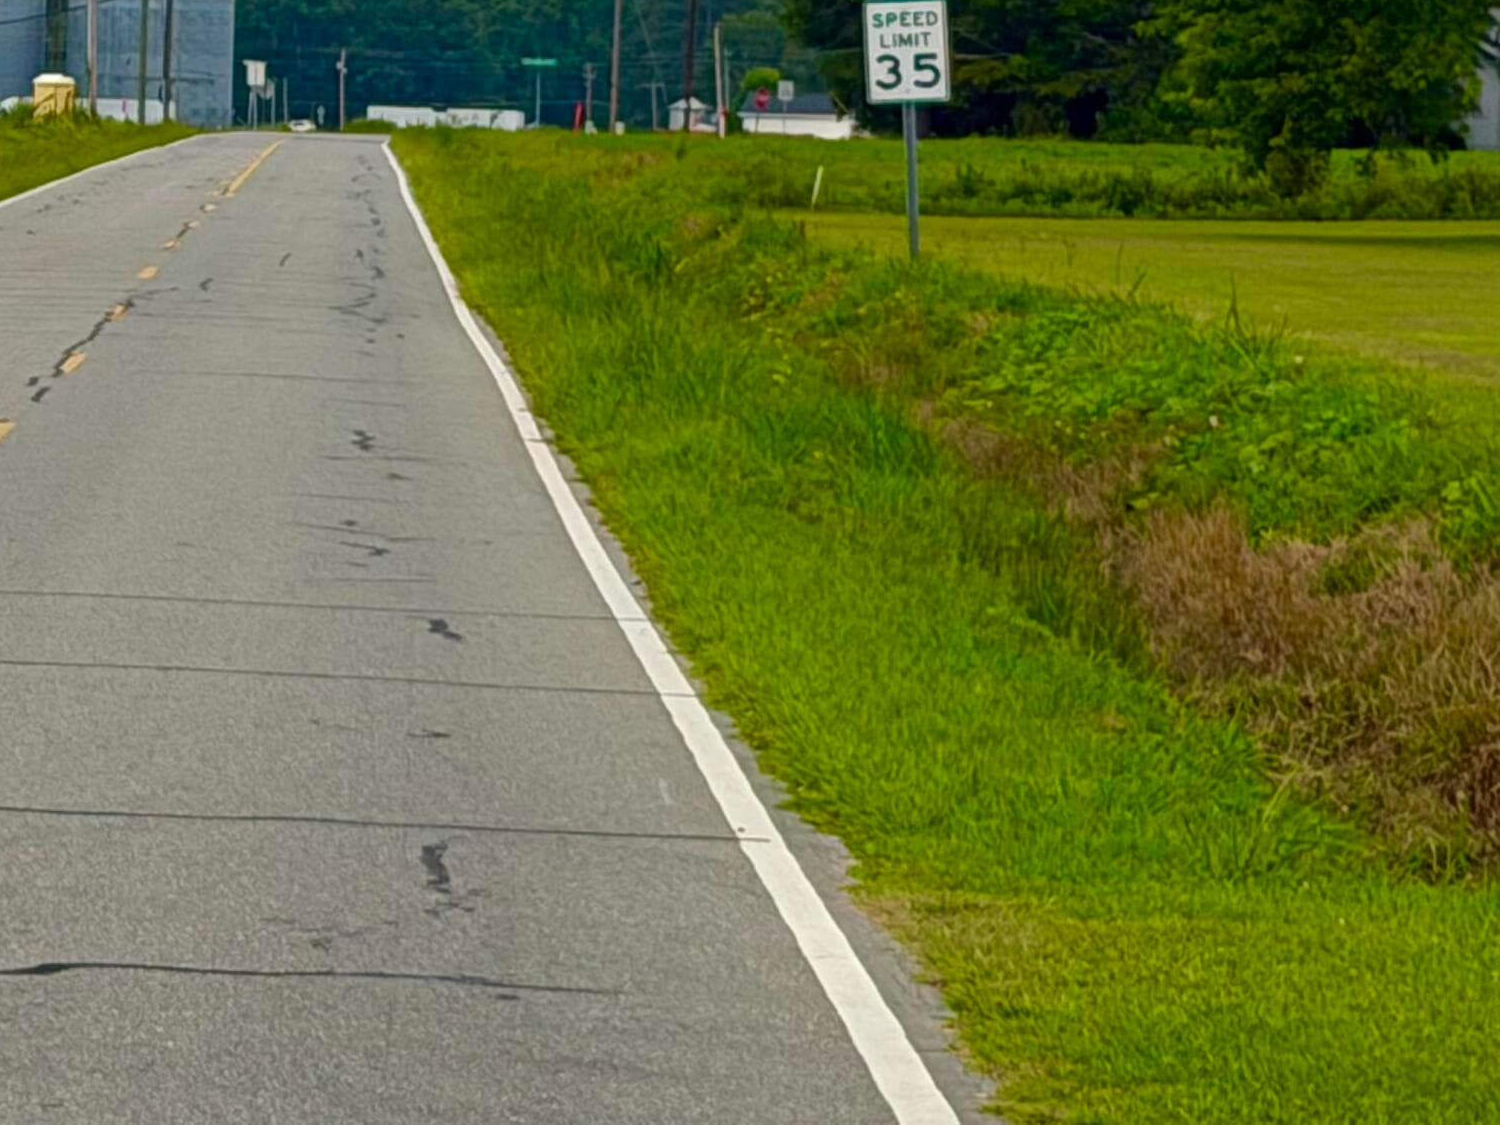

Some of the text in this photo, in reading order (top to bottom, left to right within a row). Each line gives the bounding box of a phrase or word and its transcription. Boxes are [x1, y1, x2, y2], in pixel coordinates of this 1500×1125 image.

[871, 11, 938, 28] SPEED
[879, 32, 931, 49] LIMIT
[875, 52, 941, 90] 35
